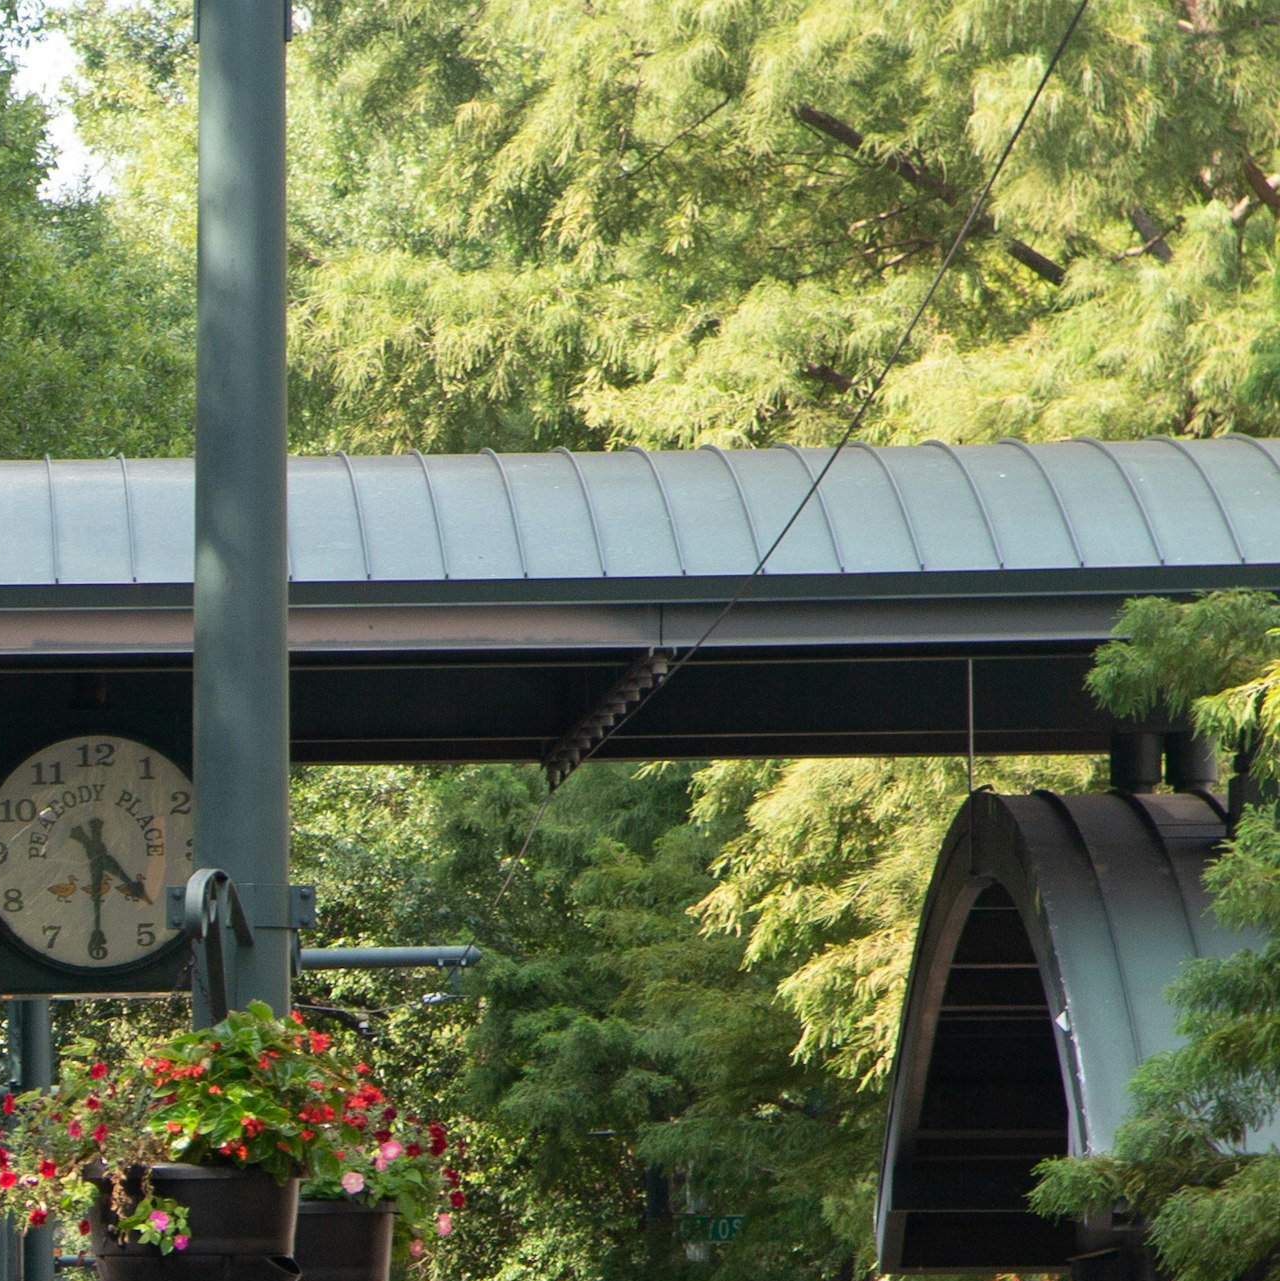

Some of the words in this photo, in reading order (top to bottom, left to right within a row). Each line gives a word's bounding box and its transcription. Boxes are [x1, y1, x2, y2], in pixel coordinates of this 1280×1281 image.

[77, 743, 115, 767] 12
[31, 762, 65, 785] 11
[139, 757, 155, 780] 1
[0, 799, 37, 822] 10
[170, 791, 191, 815] 2
[114, 789, 164, 857] PLACE
[3, 888, 24, 912] 8
[42, 925, 62, 949] 7
[136, 923, 155, 946] 5
[88, 936, 108, 960] 6
